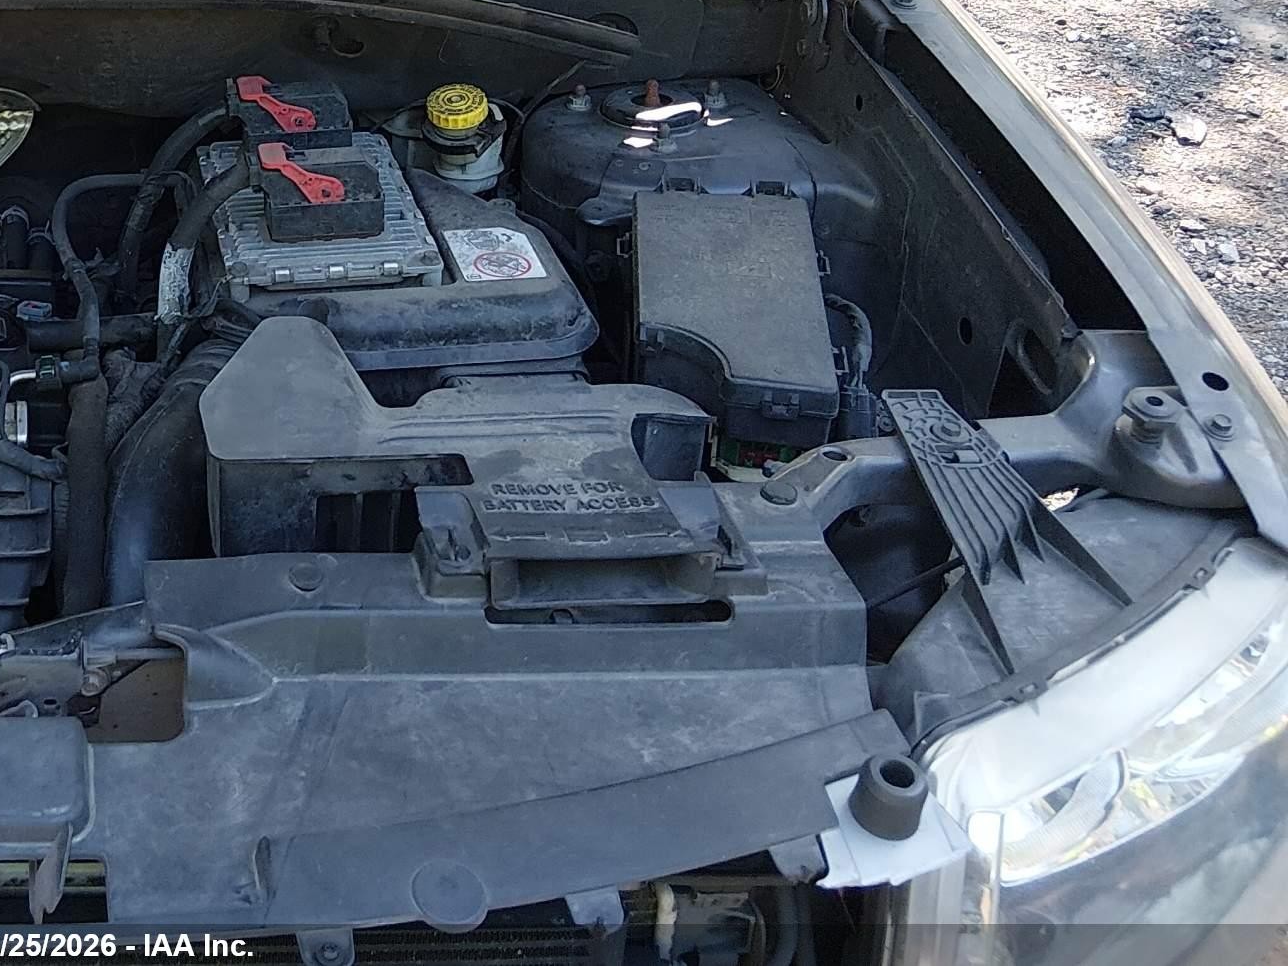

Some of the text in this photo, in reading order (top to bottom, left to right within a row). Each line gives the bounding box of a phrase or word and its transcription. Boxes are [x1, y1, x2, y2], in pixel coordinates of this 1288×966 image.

[491, 480, 624, 497] REMOVE FOR
[483, 495, 656, 513] BATTERY ACCESS
